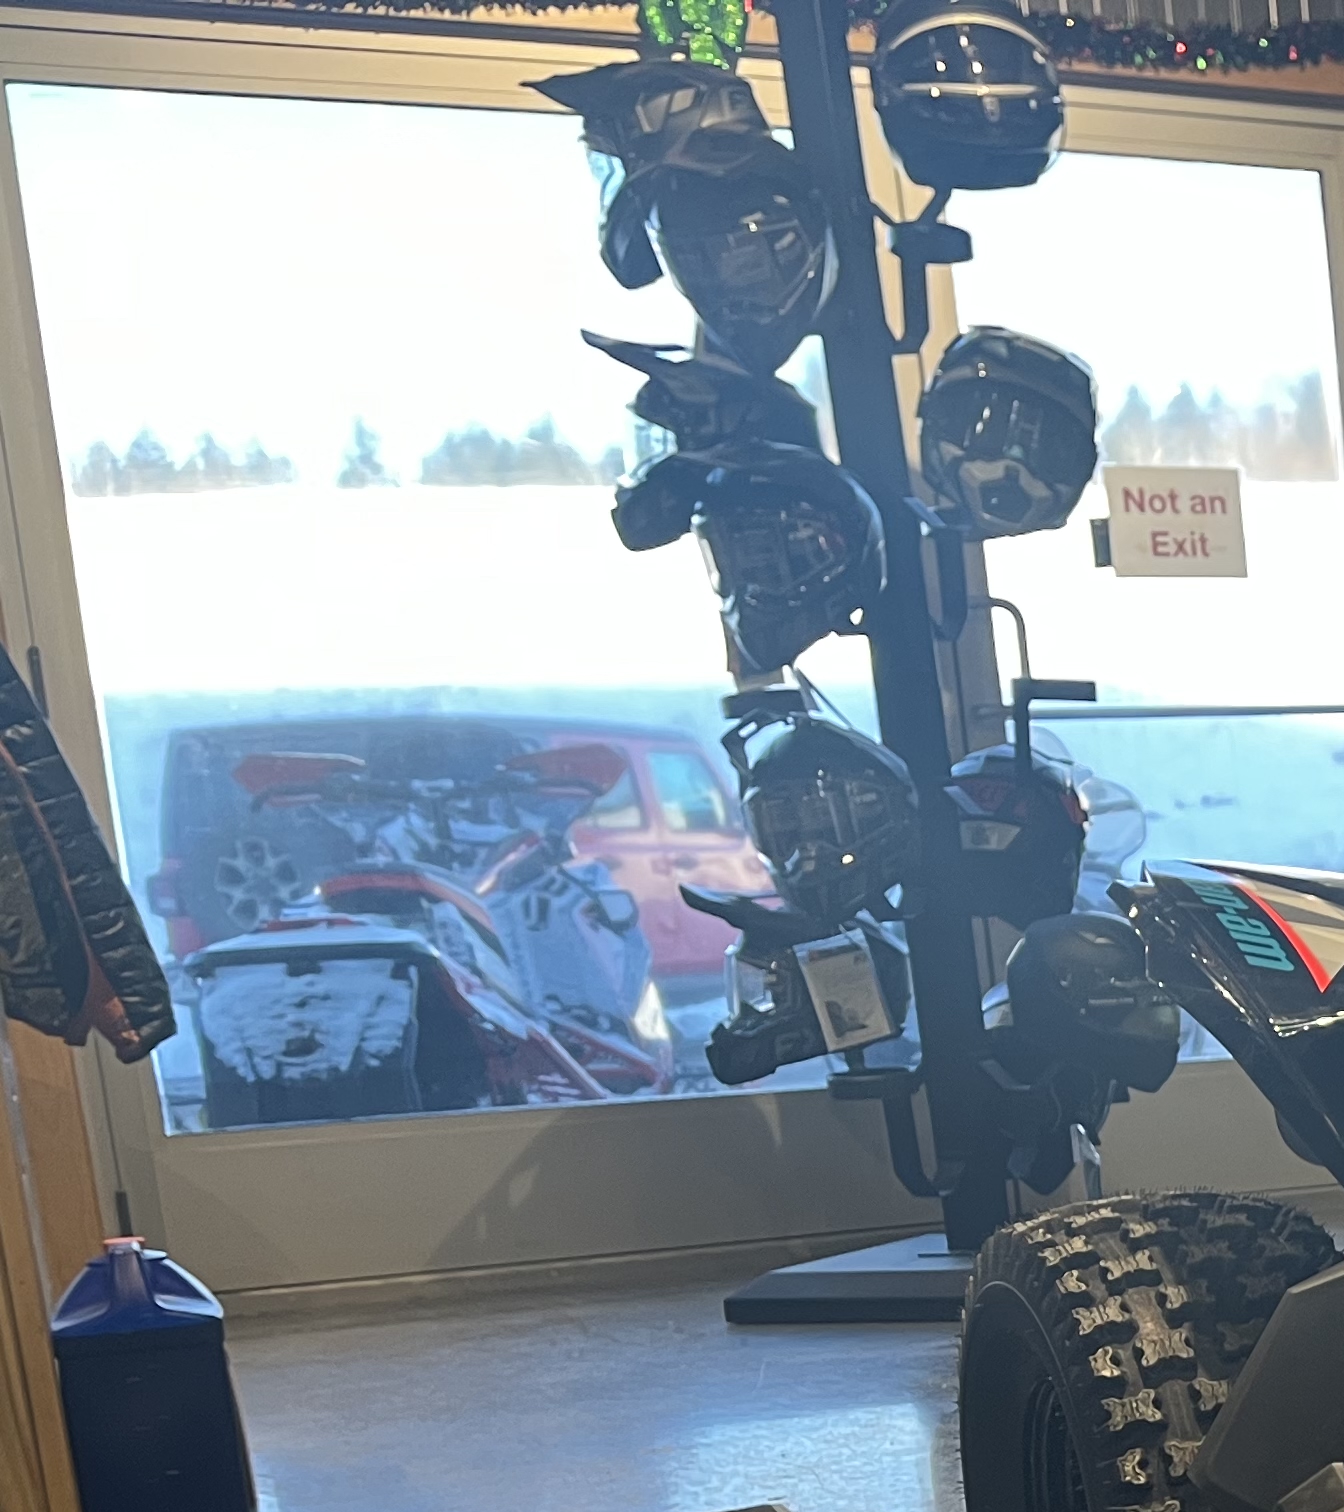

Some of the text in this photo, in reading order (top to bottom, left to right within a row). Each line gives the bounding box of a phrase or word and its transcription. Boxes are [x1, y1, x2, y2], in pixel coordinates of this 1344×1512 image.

[1122, 486, 1227, 514] Not an
[1151, 530, 1210, 557] Exit
